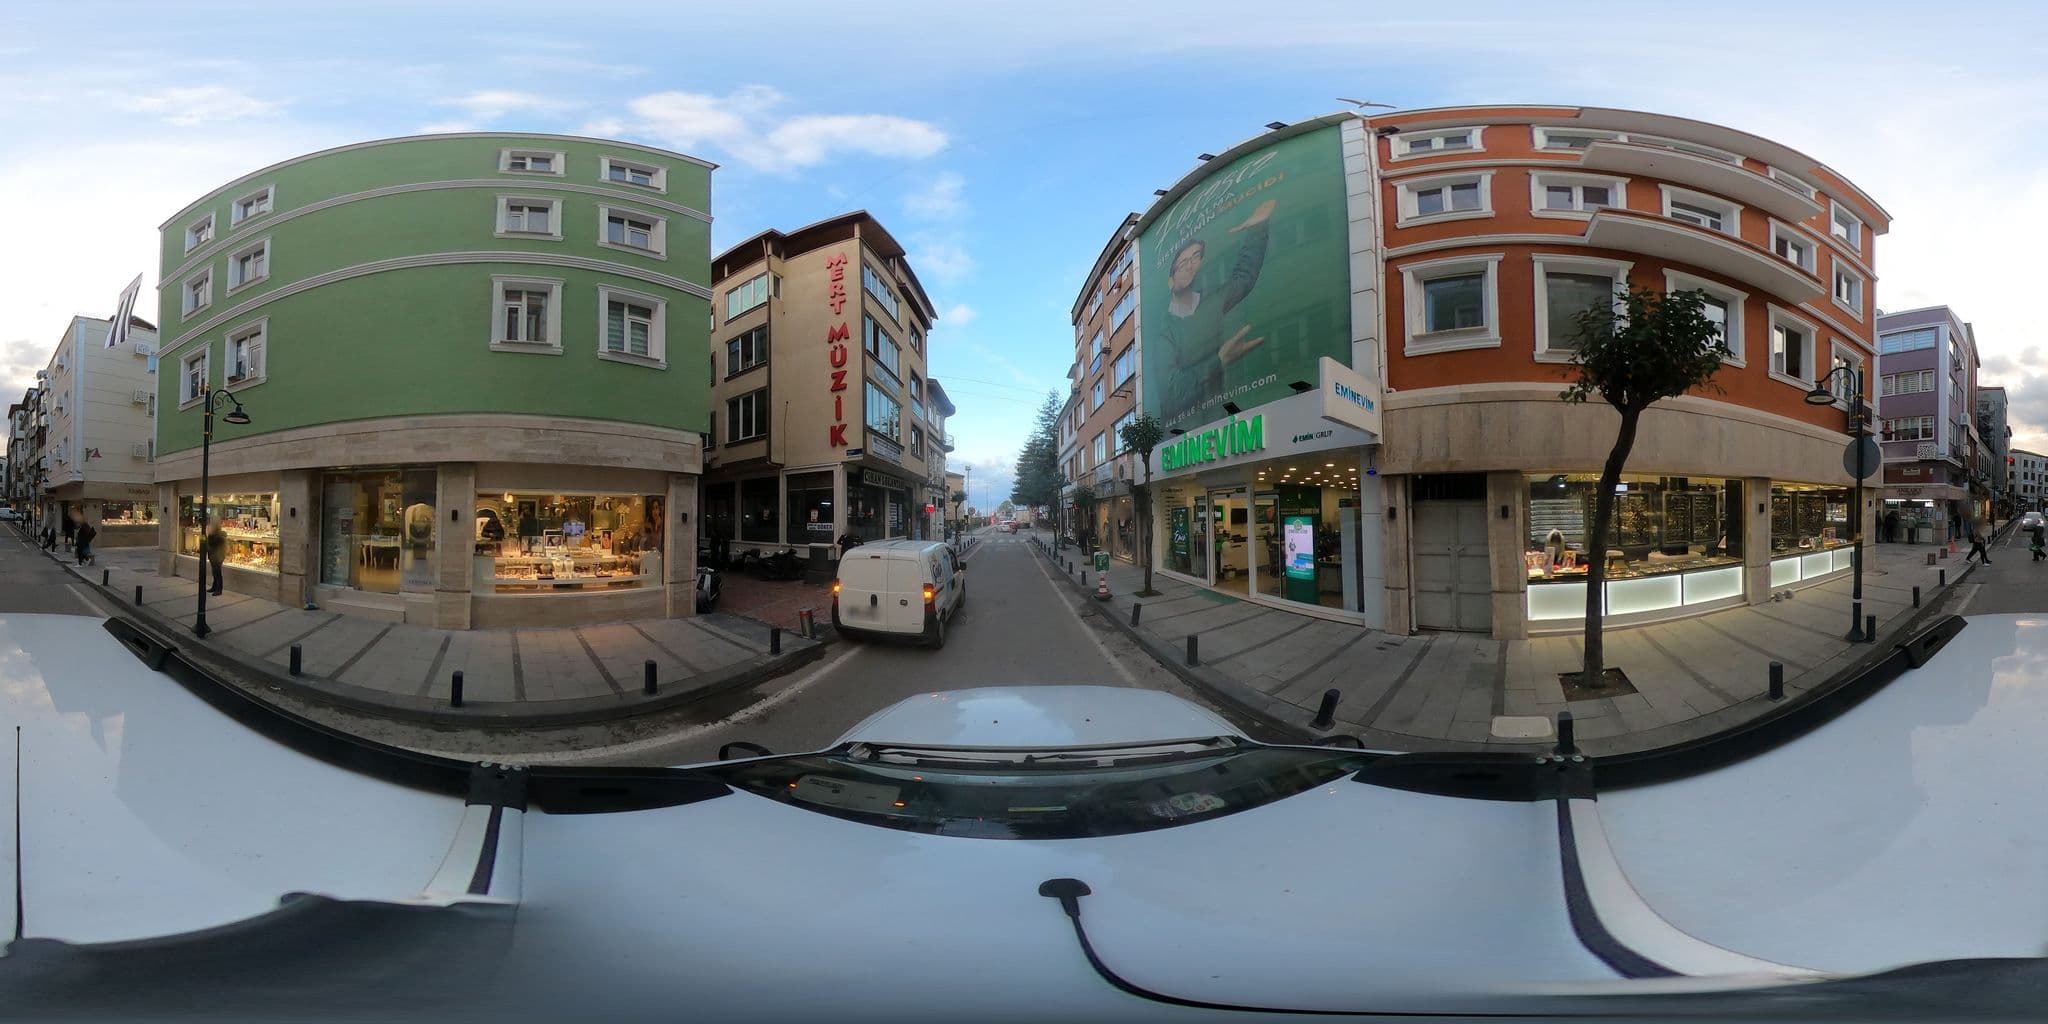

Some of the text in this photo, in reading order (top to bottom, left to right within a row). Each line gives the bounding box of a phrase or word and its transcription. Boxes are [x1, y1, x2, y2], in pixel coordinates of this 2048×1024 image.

[826, 252, 850, 448] MERT MÜZİK
[1201, 373, 1278, 410] eminevim.com
[1334, 382, 1375, 412] EMİNEVİM
[1161, 414, 1265, 472] EMİNEVİM
